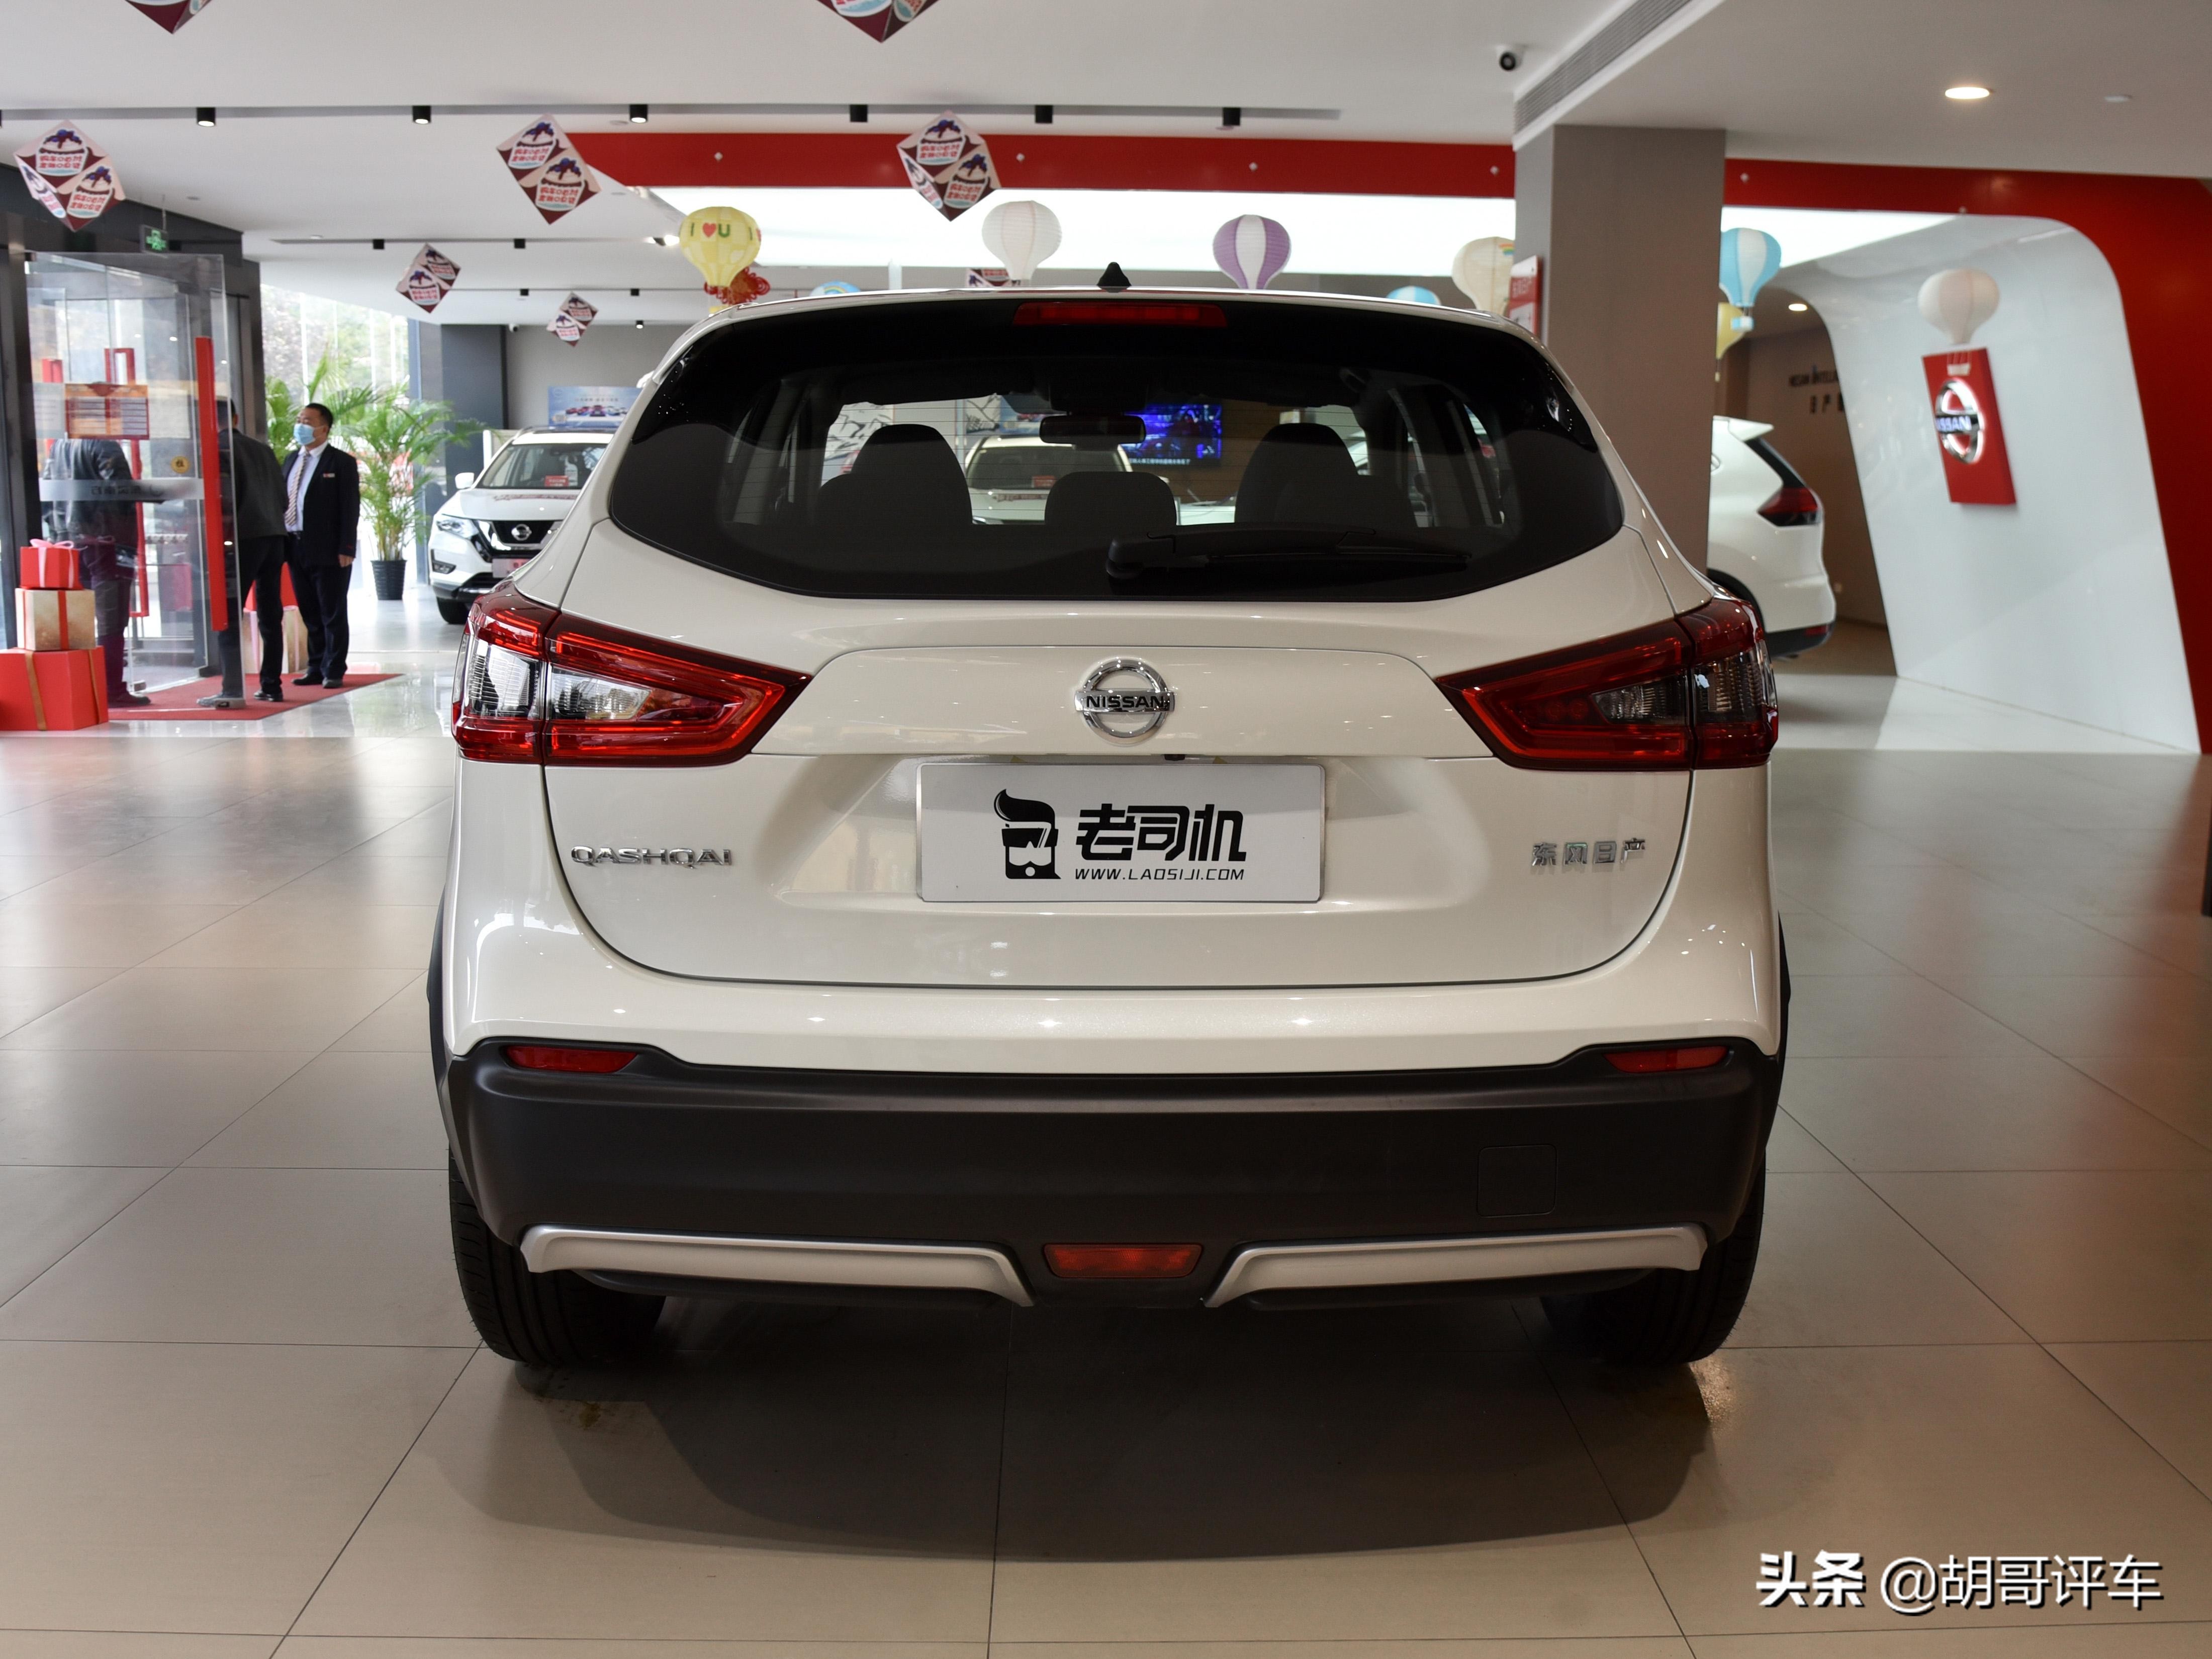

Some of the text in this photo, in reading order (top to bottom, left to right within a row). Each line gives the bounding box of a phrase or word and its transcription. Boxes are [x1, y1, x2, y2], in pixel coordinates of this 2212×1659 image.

[718, 223, 730, 238] U
[1086, 695, 1164, 708] NISSAN
[1076, 803, 1247, 862] 老司机
[571, 846, 732, 869] QASHQAI
[1532, 838, 1645, 866] 东风日产
[1075, 868, 1245, 881] WWW.LAOSIJI.COM
